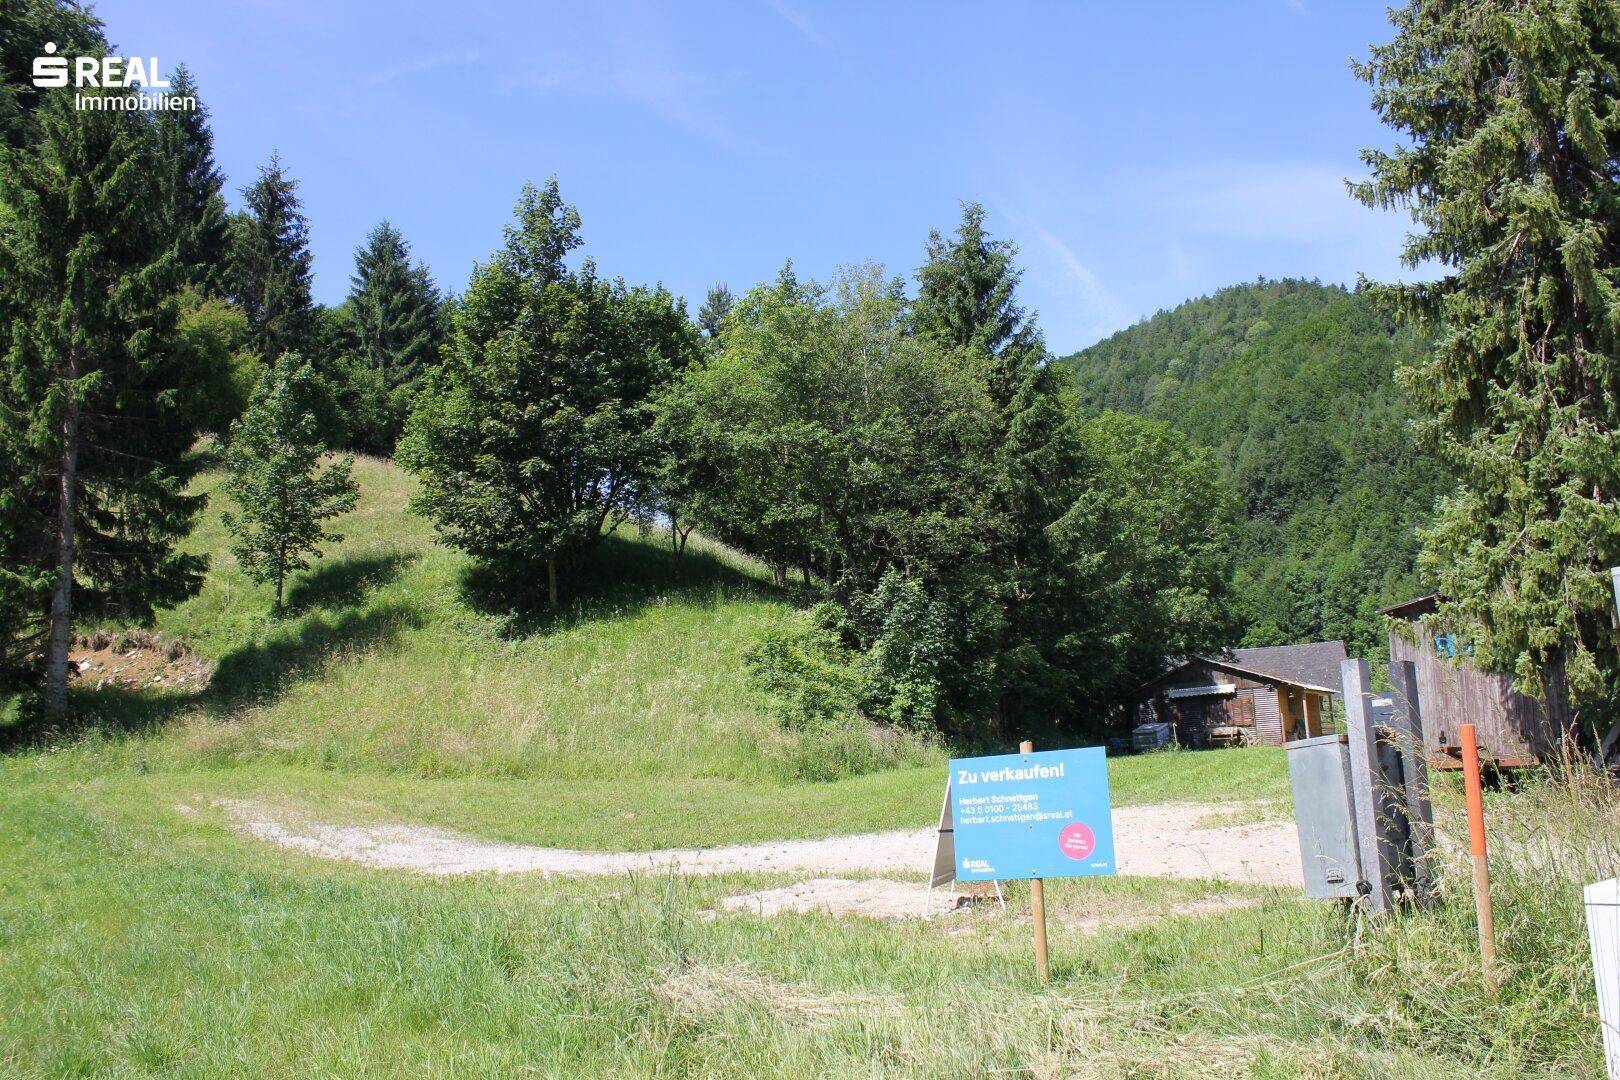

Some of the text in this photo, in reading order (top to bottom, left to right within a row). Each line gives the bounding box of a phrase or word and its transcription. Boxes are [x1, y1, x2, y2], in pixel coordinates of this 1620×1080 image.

[958, 763, 1065, 785] Zu verkaufen!
[959, 796, 990, 806] Herbert
[960, 805, 976, 815] +43
[984, 804, 1004, 814] 0100
